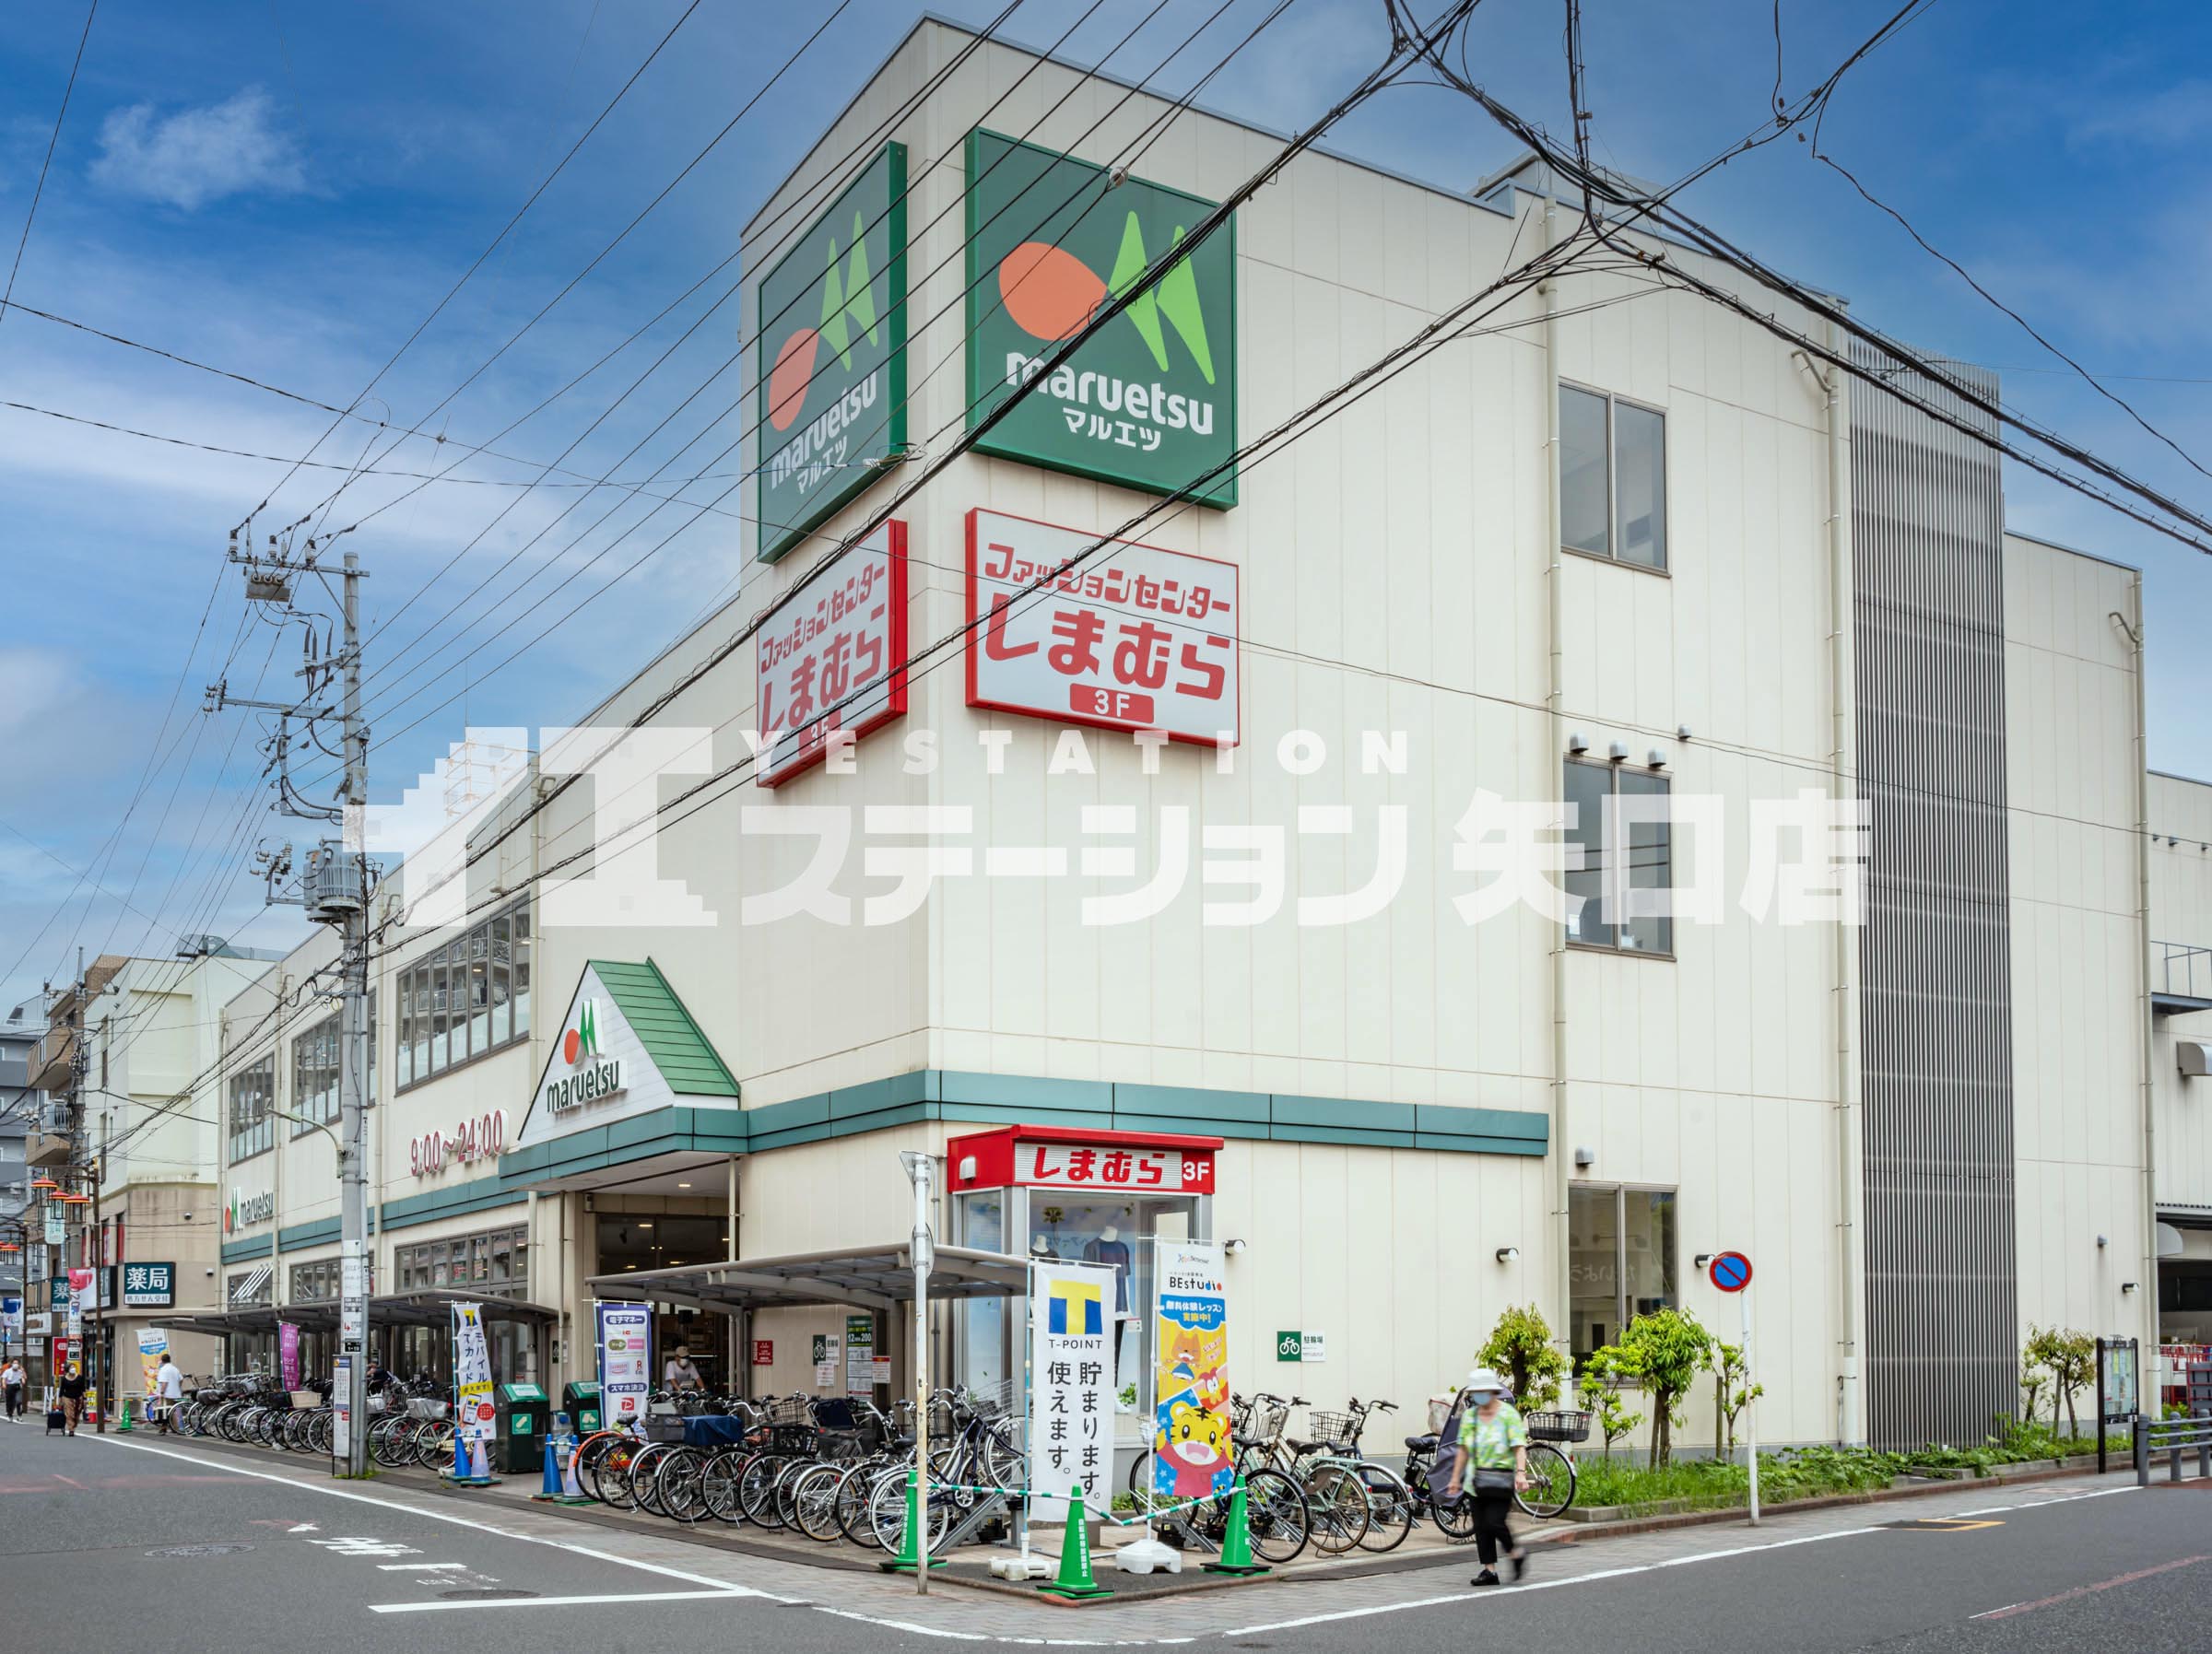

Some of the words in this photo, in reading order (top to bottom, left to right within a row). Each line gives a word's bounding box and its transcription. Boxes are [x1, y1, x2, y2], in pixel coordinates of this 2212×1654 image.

[1006, 352, 1213, 436] maruetsu
[771, 370, 877, 490] maruetsu
[1063, 408, 1161, 451] マルエツ
[797, 435, 847, 495] マルエツ
[985, 543, 1230, 620] ファッションセンター
[761, 562, 885, 674] ファッションセンター
[763, 604, 885, 743] しまむら
[985, 592, 1230, 701] しまむら
[1094, 690, 1130, 718] 3F
[546, 1061, 619, 1113] maruetsu
[1033, 1146, 1165, 1184] しまむら
[1182, 1161, 1209, 1181] 3F
[240, 1190, 274, 1225] maruetsu
[127, 1267, 169, 1290] 薬局
[1170, 1276, 1222, 1291] BEstudio
[475, 1332, 488, 1383] モバイル
[1049, 1339, 1103, 1350] T-POINT
[1048, 1361, 1072, 1474] 使えます。
[1079, 1361, 1101, 1500] 貯まります。
